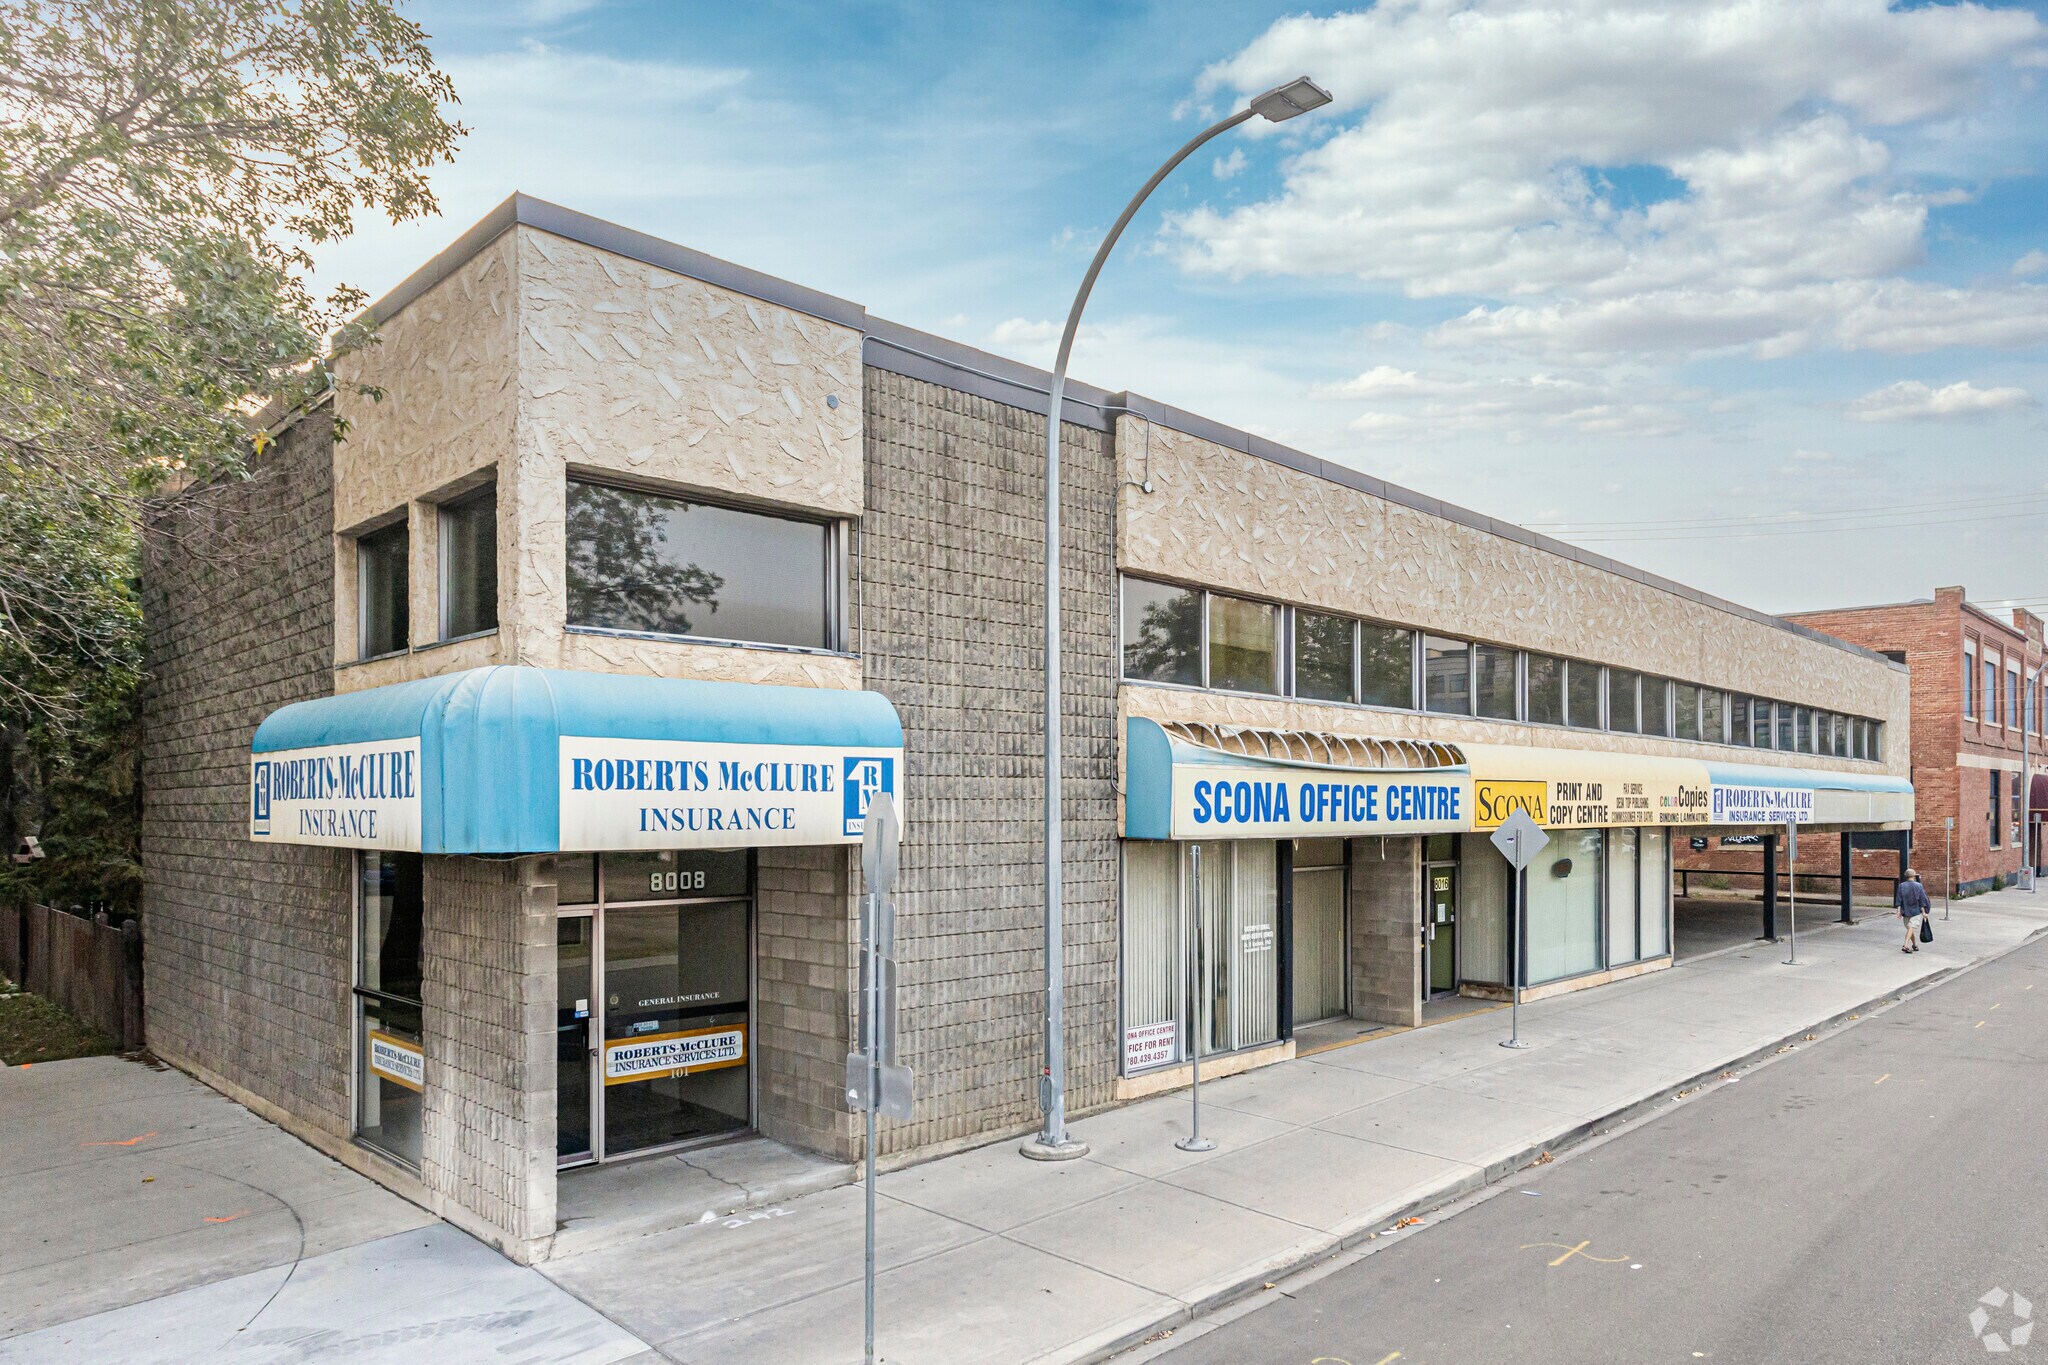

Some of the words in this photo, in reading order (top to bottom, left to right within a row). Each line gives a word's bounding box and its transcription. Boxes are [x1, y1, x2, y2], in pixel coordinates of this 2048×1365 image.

[273, 750, 415, 800] ROBERTS-McCLURE
[571, 758, 709, 792] ROBERTS
[719, 761, 835, 792] McCLURE
[1193, 780, 1290, 824] SCONA
[1300, 783, 1378, 822] OFFICE
[1386, 784, 1460, 821] CENTRE
[1556, 782, 1583, 801] PRINT
[1586, 783, 1602, 801] AND
[1678, 785, 1708, 812] Copies
[1726, 789, 1812, 808] ROBERTS-McCLURE
[299, 809, 378, 839] INSURANCE
[639, 807, 796, 832] INSURANCE
[1550, 805, 1574, 825] COPY
[1576, 805, 1608, 824] CENTRE
[1660, 813, 1679, 823] BINDING
[1680, 813, 1708, 822] LAMINATING
[1729, 811, 1766, 822] INSURANCE
[1768, 811, 1796, 822] SERVICES
[650, 870, 705, 892] 8008
[638, 997, 675, 1007] GENERAL
[677, 991, 720, 1003] INSURANCE
[1138, 1028, 1156, 1038] OFFICE
[1156, 1024, 1174, 1035] CENTRE
[614, 1035, 736, 1061] ROBERTS-McCLURE
[1127, 1042, 1143, 1053] FICE
[1144, 1039, 1157, 1050] FOR
[1158, 1036, 1174, 1047] RENT
[615, 1055, 671, 1073] INSURANCE
[672, 1049, 717, 1065] SERVICES
[717, 1046, 737, 1058] LTD.
[670, 1067, 689, 1079] 101
